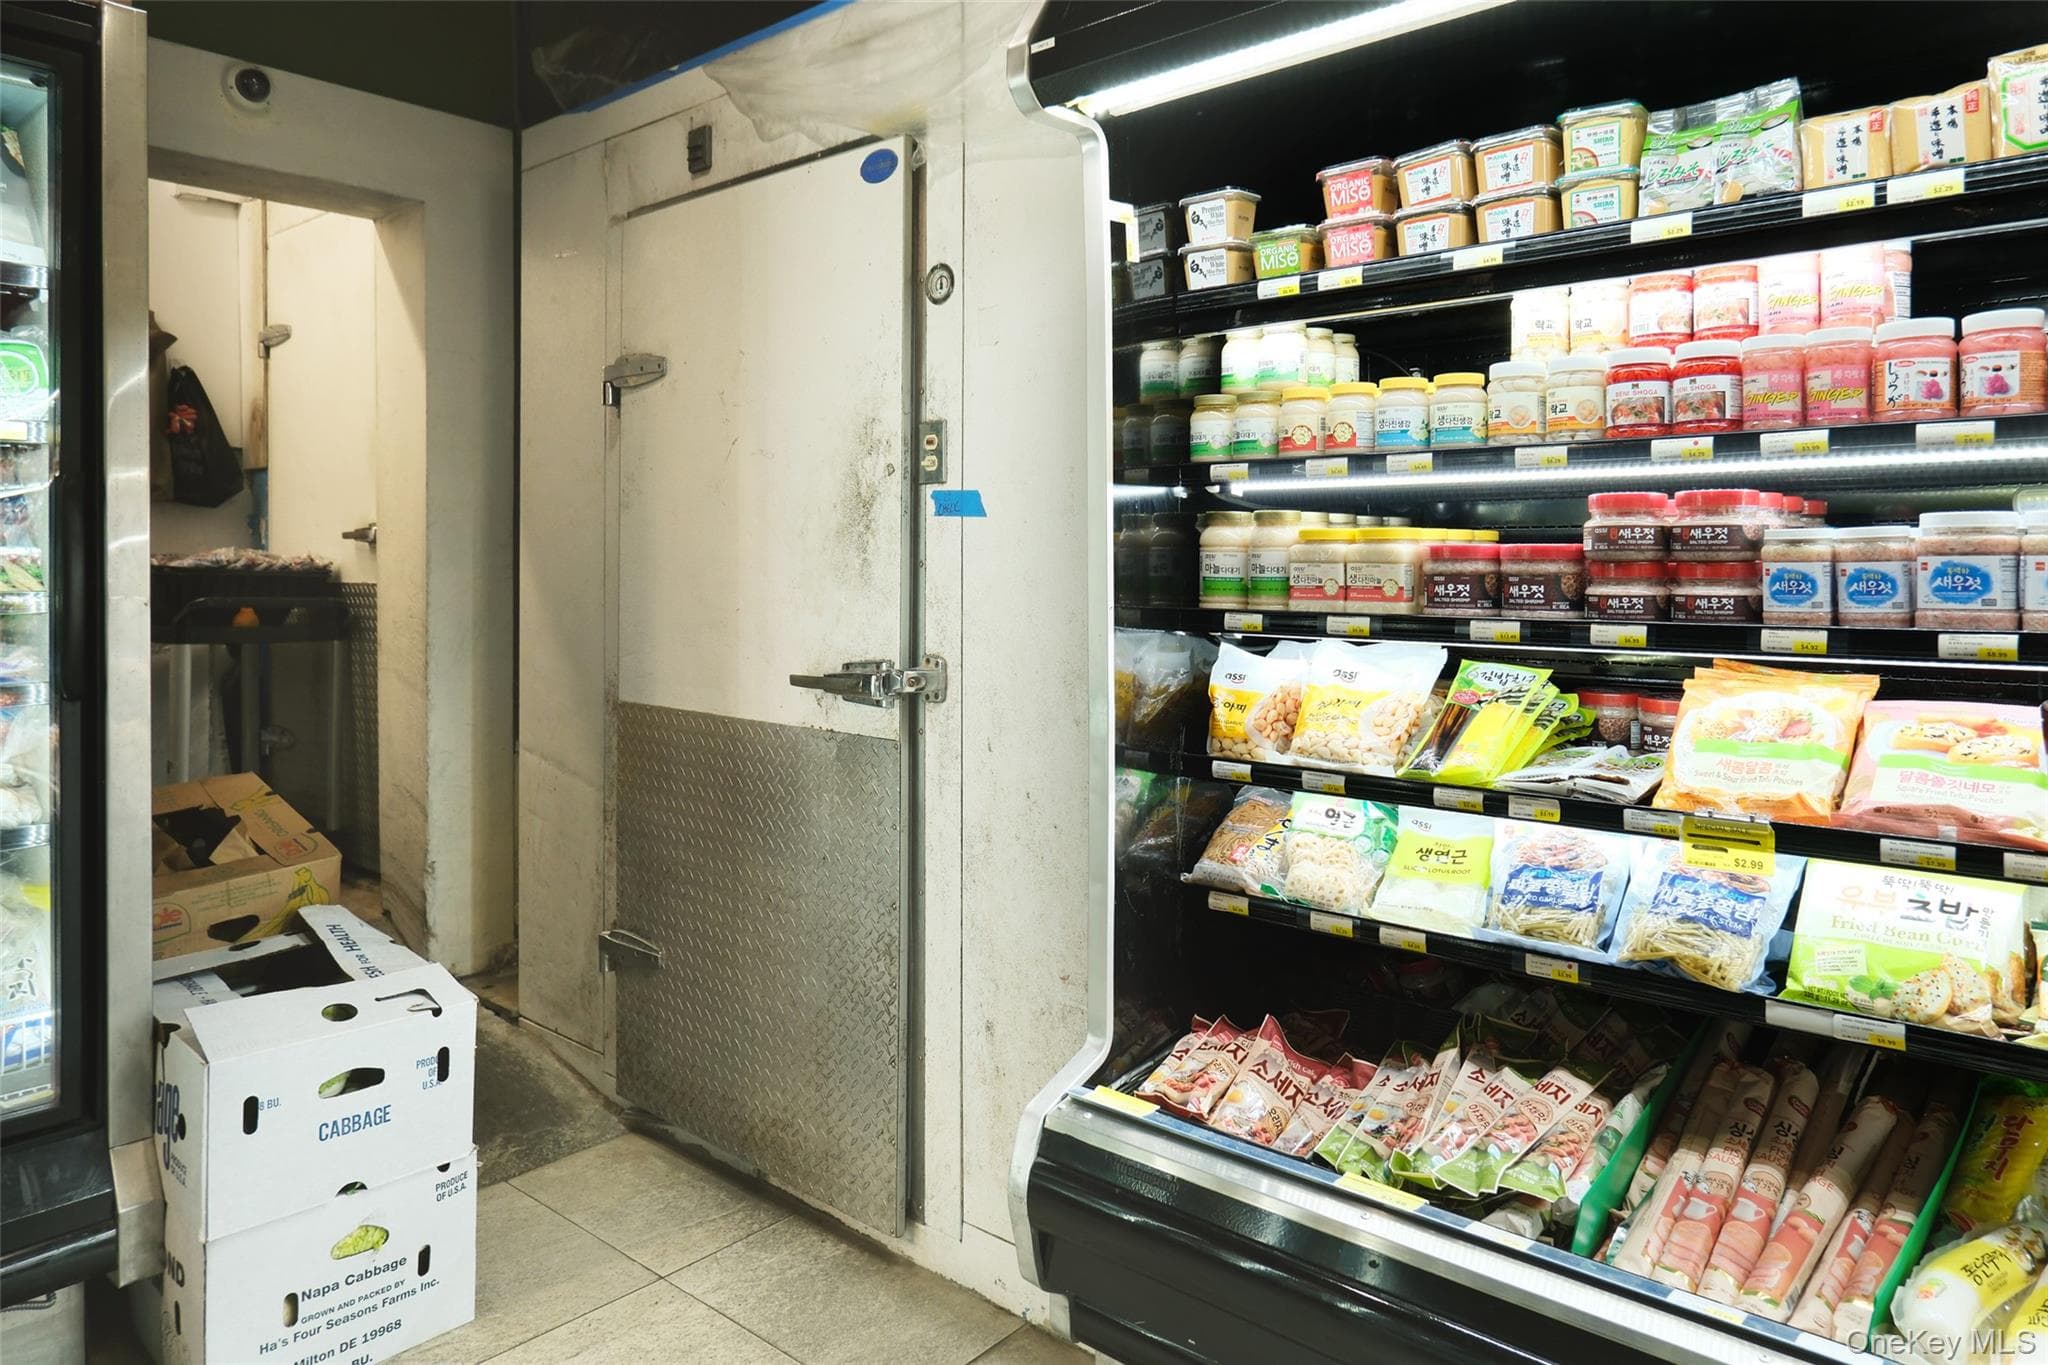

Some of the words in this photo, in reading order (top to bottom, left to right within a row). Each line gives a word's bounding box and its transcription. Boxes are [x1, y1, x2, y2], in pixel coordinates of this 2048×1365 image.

[1594, 135, 1615, 144] SHIRO
[1330, 176, 1370, 192] ORGANIC
[1331, 186, 1371, 207] MISO
[1594, 200, 1615, 209] SHIRO
[1330, 230, 1371, 244] ORGANIC
[1260, 244, 1298, 256] ORGANIC
[1331, 239, 1372, 260] MISO
[1260, 252, 1299, 271] MISO
[1830, 284, 1884, 302] GINGER
[1767, 294, 1818, 309] GINGER
[1632, 388, 1658, 396] SHOGA
[1690, 383, 1717, 391] SHOGA
[1808, 387, 1864, 403] GINGER
[1744, 391, 1799, 407] GINGER
[1378, 419, 1411, 430] 생다진생강
[1437, 415, 1473, 426] 생다진생강
[1618, 526, 1656, 540] 새우젓
[1689, 527, 1728, 540] 새우젓
[1292, 573, 1324, 585] 생다진마늘
[1349, 573, 1382, 585] 생다진마늘
[1771, 580, 1813, 594] 새우젓
[1931, 575, 1983, 591] 새우젓
[1434, 583, 1470, 598] 새우젓
[1509, 584, 1545, 599] 새우젓
[1848, 580, 1893, 595] 새우젓
[1607, 597, 1645, 610] 새우젓
[1694, 597, 1735, 610] 새우젓
[1225, 672, 1247, 682] assi
[1333, 667, 1359, 680] assi
[1411, 818, 1432, 831] assi
[1415, 846, 1468, 866] 생연근
[1734, 857, 1764, 870] $2.99
[152, 907, 184, 924] ole
[1830, 914, 1879, 934] Fried
[1883, 924, 1932, 941] Bean
[326, 924, 363, 953] HEALTH
[1248, 1058, 1305, 1109] 소세지
[1392, 1069, 1442, 1092] 소세지
[1483, 1082, 1514, 1109] 세지
[1534, 1079, 1572, 1105] 세지
[266, 1097, 282, 1109] BU.
[1574, 1101, 1605, 1128] 세지
[318, 1104, 393, 1142] CABBAGE
[1706, 1152, 1744, 1169] SAUSA
[435, 1170, 469, 1192] PRODUCE
[436, 1191, 447, 1202] OF
[447, 1182, 467, 1199] U.S.A.
[301, 1281, 340, 1302] Napa
[344, 1256, 408, 1286] Cabbage
[301, 1306, 335, 1325] GROWN
[337, 1298, 356, 1311] AND
[357, 1284, 393, 1304] PACKED
[394, 1278, 406, 1289] BY
[259, 1336, 290, 1355] Ha's
[292, 1325, 322, 1343] Four
[325, 1303, 379, 1330] Seasons
[381, 1288, 417, 1308] Farms
[419, 1278, 440, 1293] Inc.
[293, 1349, 335, 1365] Milton
[339, 1337, 358, 1354] DE
[360, 1318, 403, 1345] 19968
